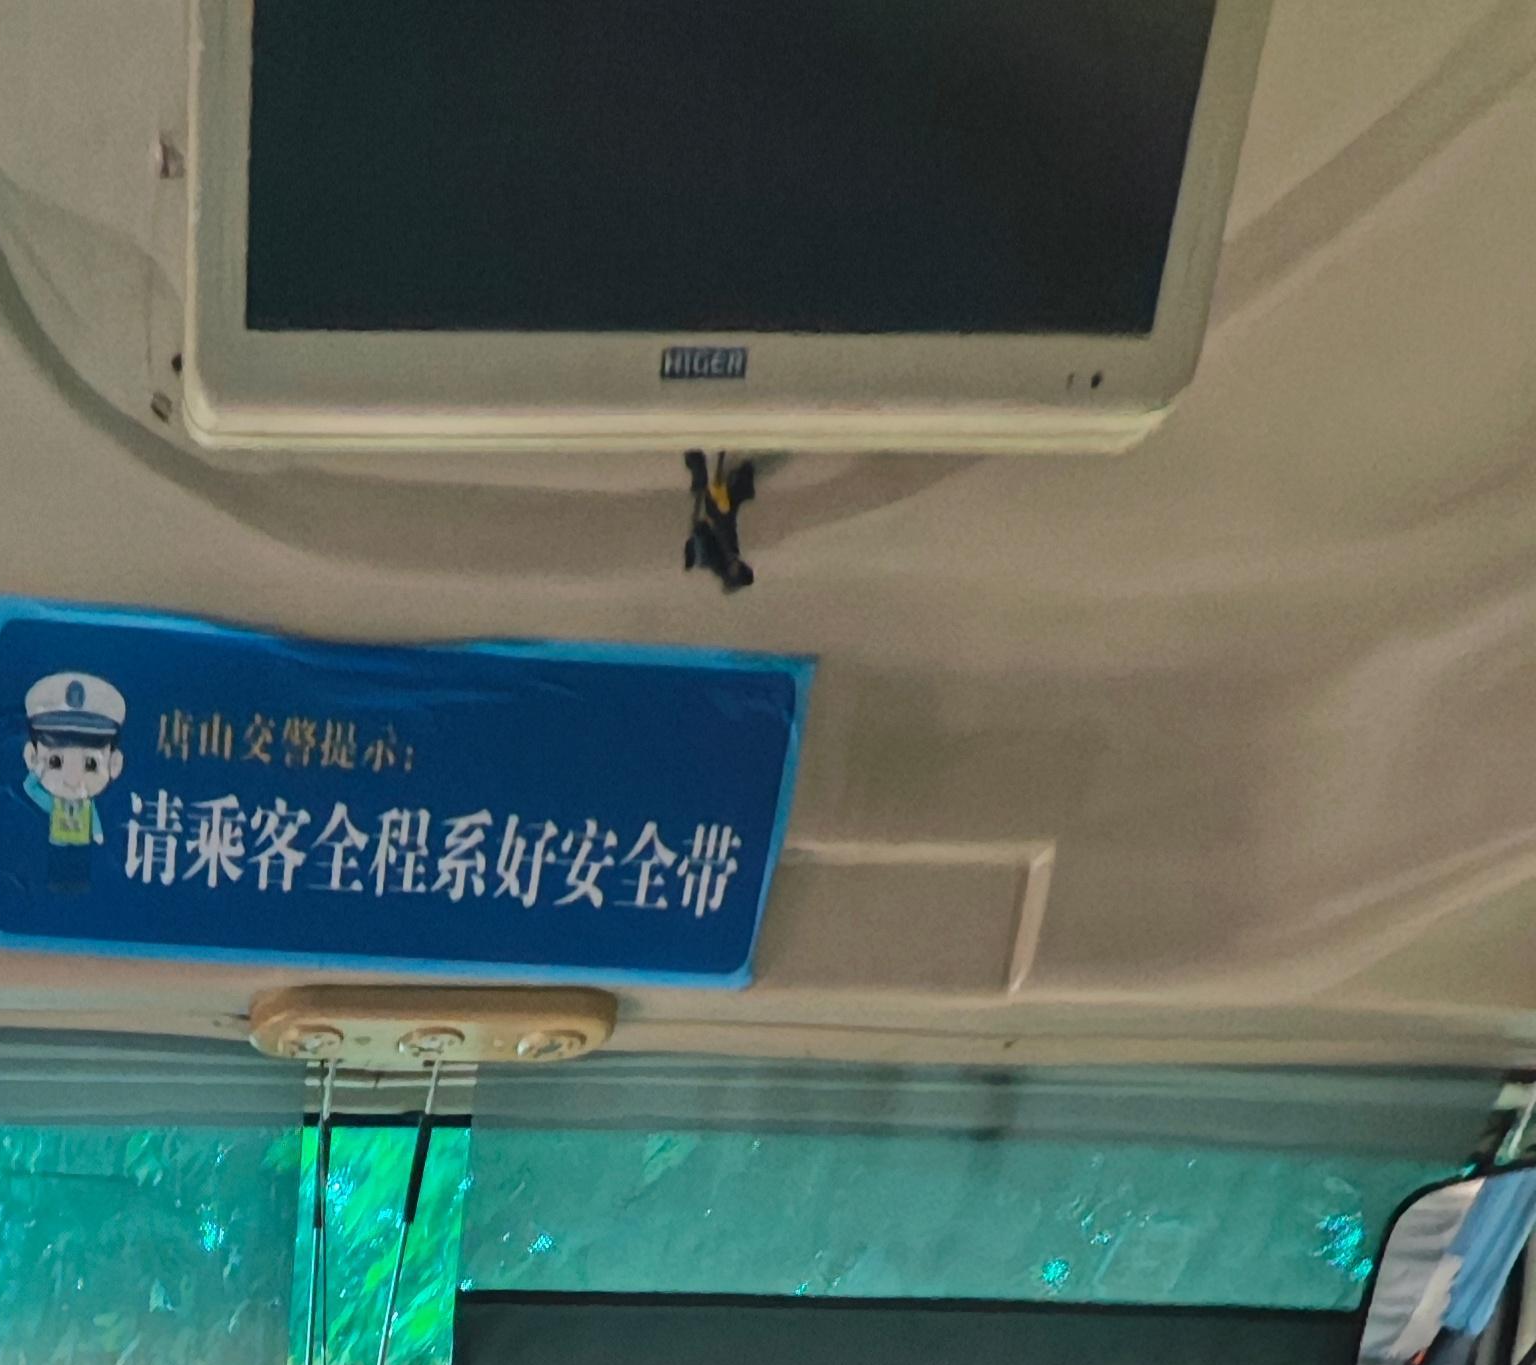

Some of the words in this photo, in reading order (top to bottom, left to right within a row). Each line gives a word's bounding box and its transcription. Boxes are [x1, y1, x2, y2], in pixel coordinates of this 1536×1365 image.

[121, 790, 741, 917] 请乘客全程系好安全带
